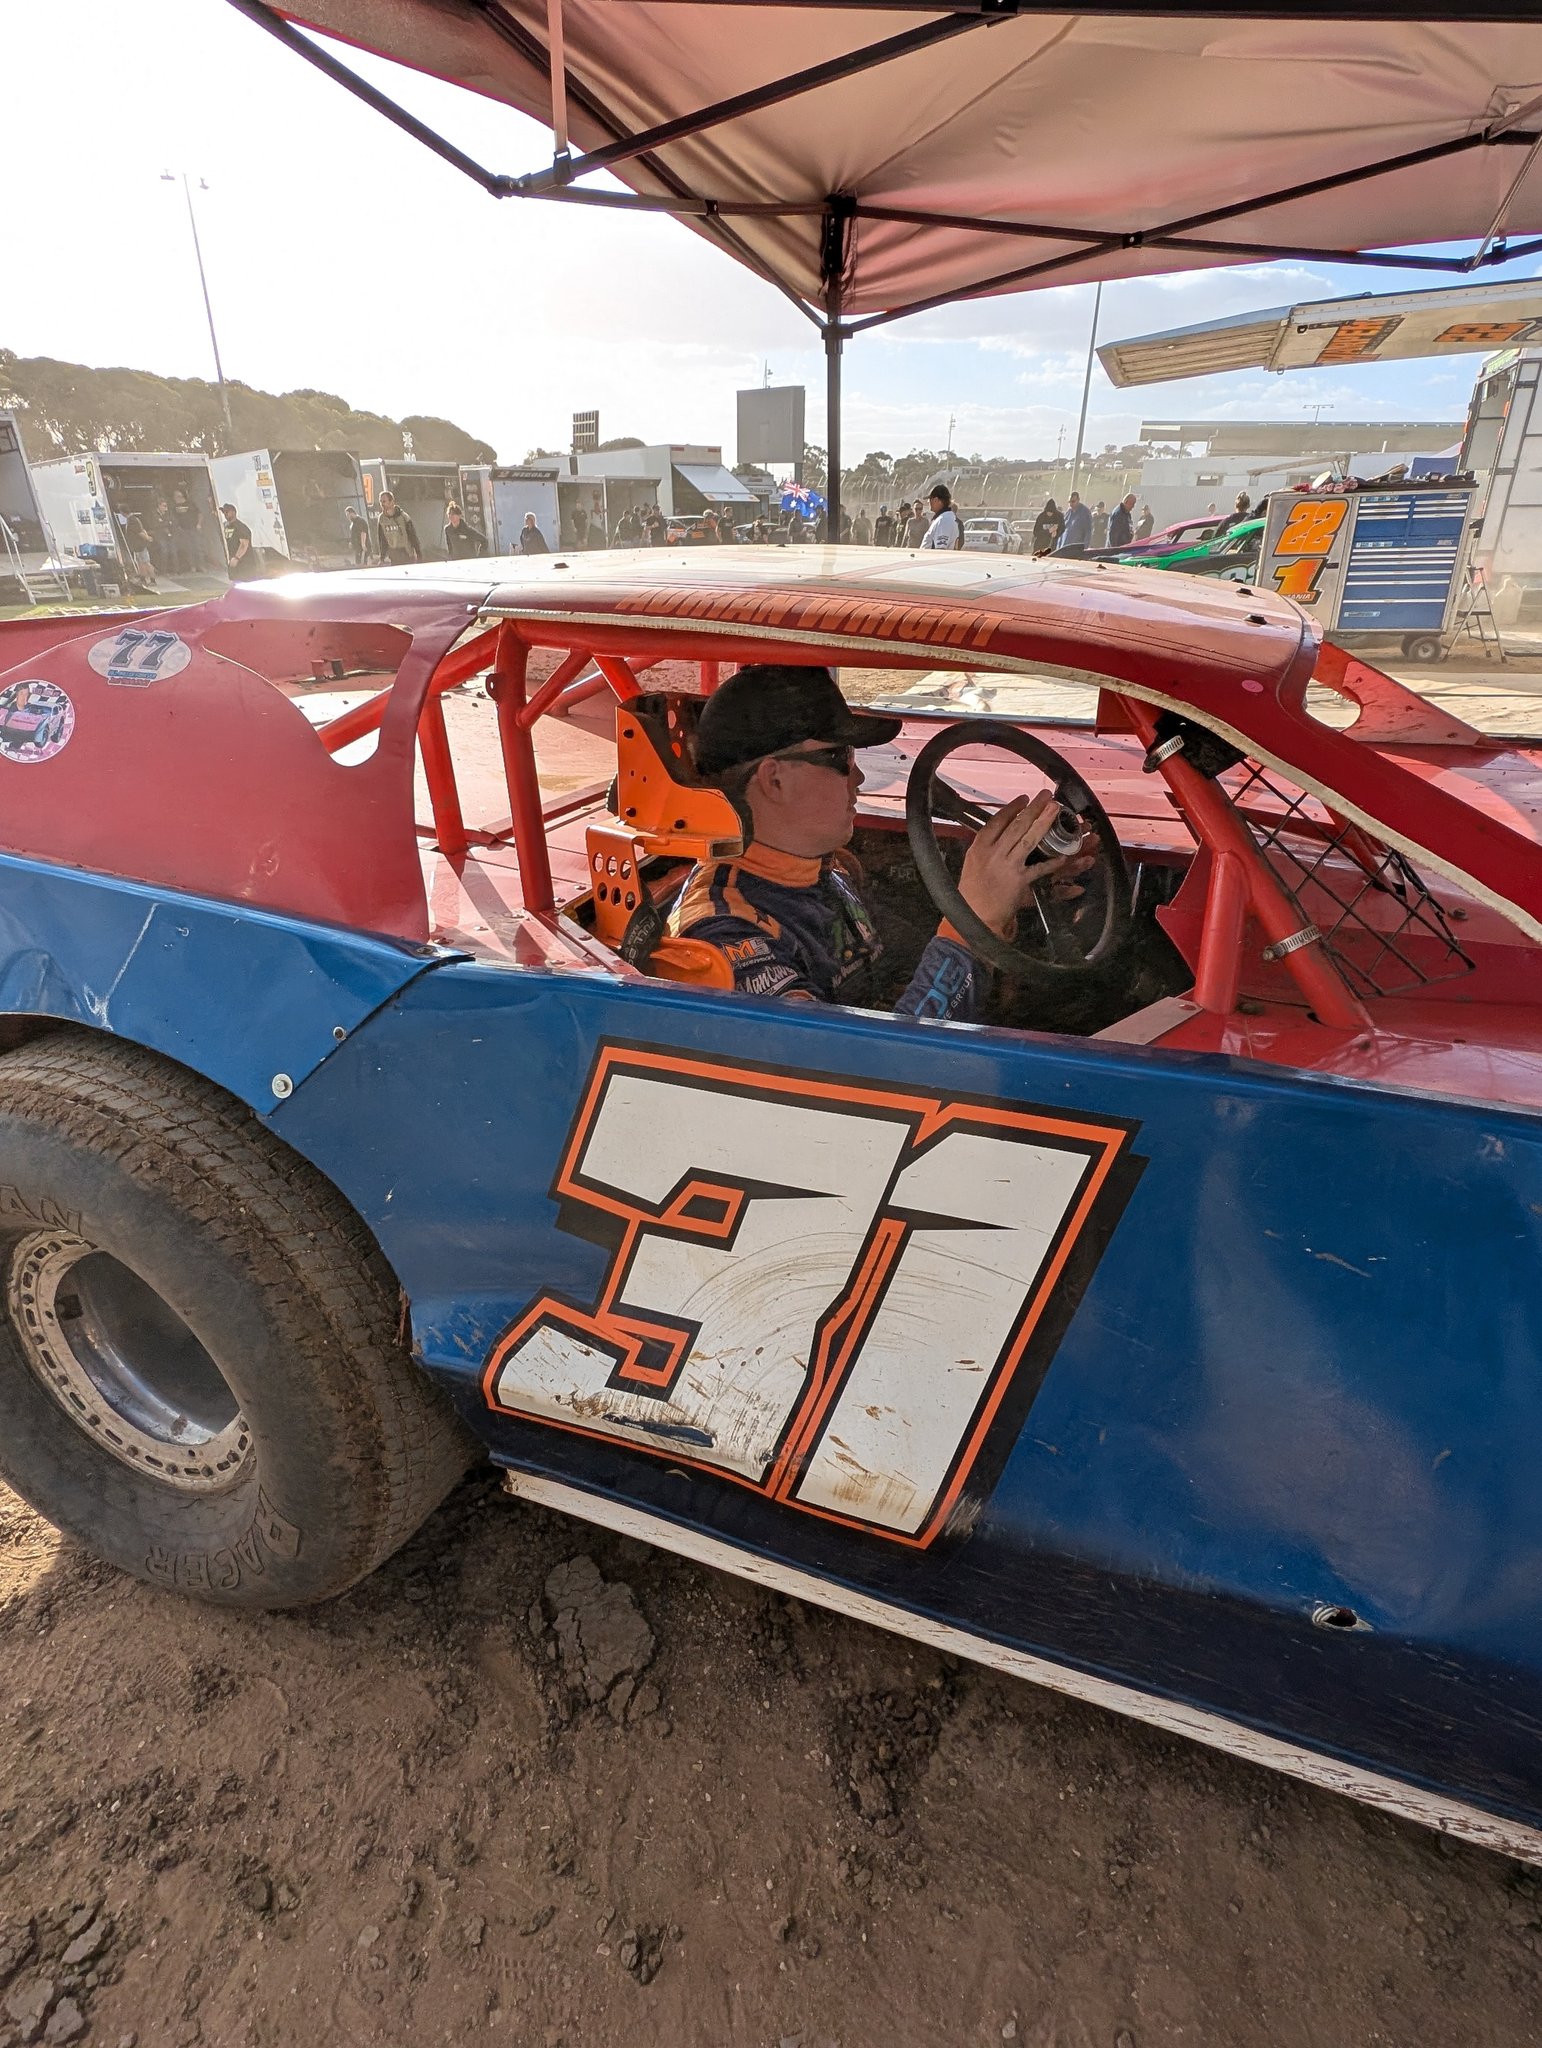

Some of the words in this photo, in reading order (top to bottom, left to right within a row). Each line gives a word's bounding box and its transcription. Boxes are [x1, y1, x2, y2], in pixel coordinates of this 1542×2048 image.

[1273, 499, 1349, 557] 22
[1272, 558, 1328, 605] 1
[615, 587, 806, 626] ADRIAN
[797, 600, 1012, 648] WRIGHT
[109, 629, 178, 670] 77
[951, 972, 975, 1008] GROUP
